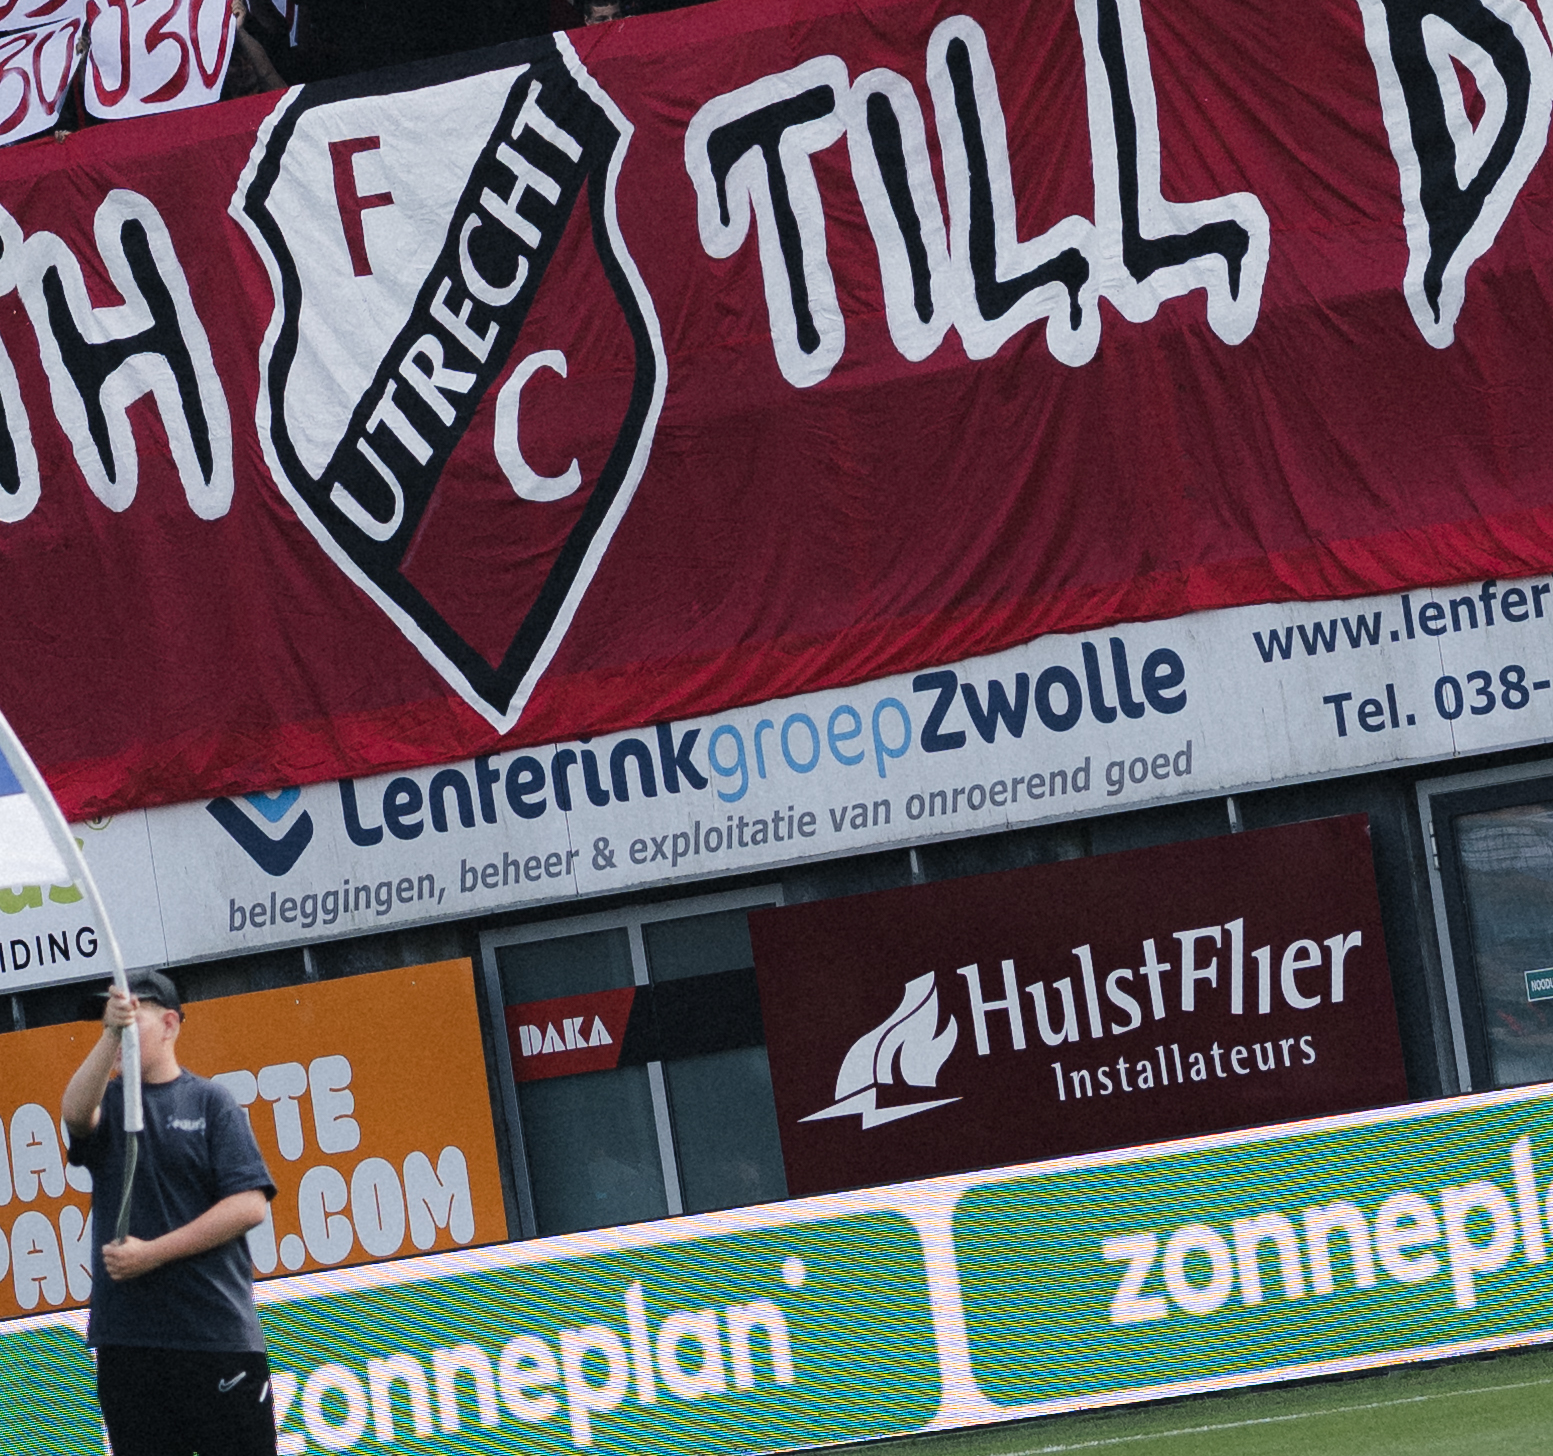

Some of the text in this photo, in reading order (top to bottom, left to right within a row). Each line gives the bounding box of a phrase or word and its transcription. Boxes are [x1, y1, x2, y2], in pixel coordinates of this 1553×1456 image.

[326, 134, 396, 278] F
[329, 80, 585, 542] UTRECHT
[493, 348, 582, 502] C
[1323, 685, 1418, 738] Tel.
[229, 739, 1194, 934] beleggingen, beheer & exploitatie van onroerend goed
[519, 1015, 614, 1058] DAKA
[956, 917, 1362, 1056] HulstFlier
[1051, 1030, 1317, 1102] Installateurs
